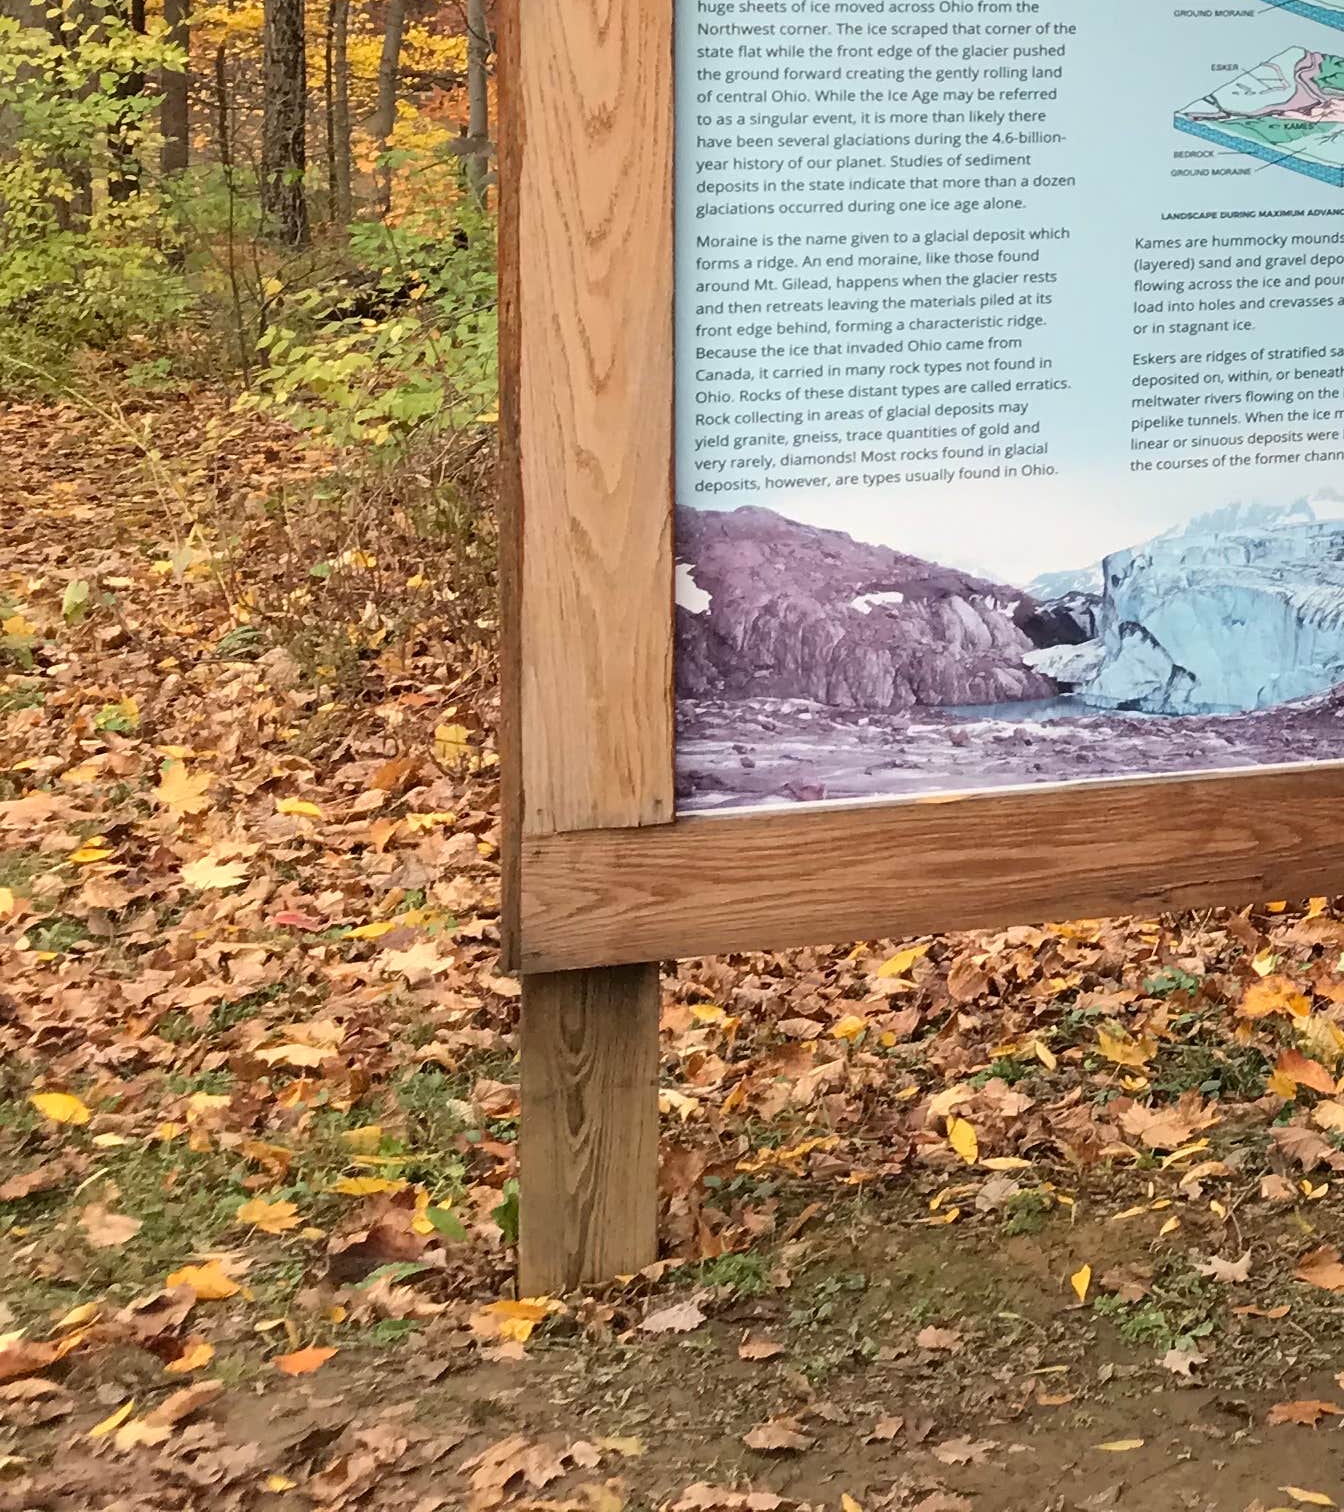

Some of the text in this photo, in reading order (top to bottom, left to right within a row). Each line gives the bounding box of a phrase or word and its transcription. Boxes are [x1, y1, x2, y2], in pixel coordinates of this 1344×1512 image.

[695, 196, 1026, 219] glaciations occurred during one ice age alone.
[1160, 211, 1218, 221] LANDSCAPE
[1219, 210, 1256, 219] DURING
[1258, 209, 1305, 218] MAXIMUM
[1134, 237, 1182, 250] Kames
[1184, 238, 1208, 248] are
[1211, 233, 1288, 249] hummocky
[694, 463, 1059, 495] deposits, however, are types usually found in Ohio.
